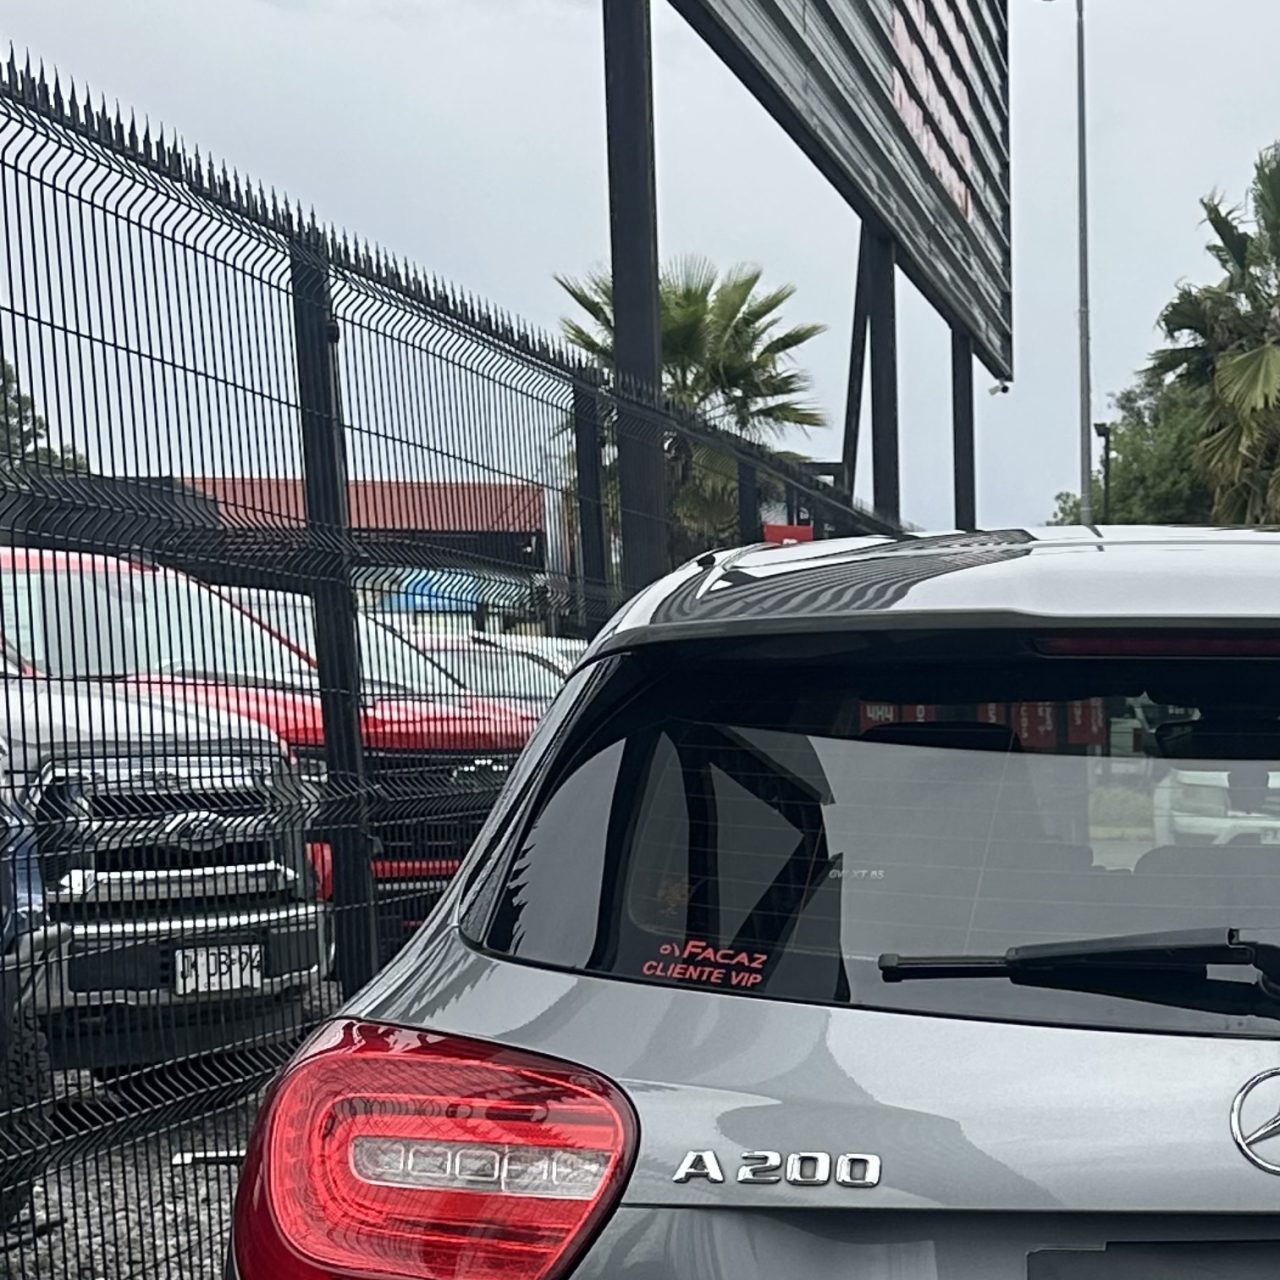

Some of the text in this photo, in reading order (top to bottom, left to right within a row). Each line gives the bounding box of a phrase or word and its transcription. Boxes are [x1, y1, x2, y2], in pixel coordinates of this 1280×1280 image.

[642, 961, 763, 988] CLIENTE VIP
[672, 1150, 882, 1188] A 200
